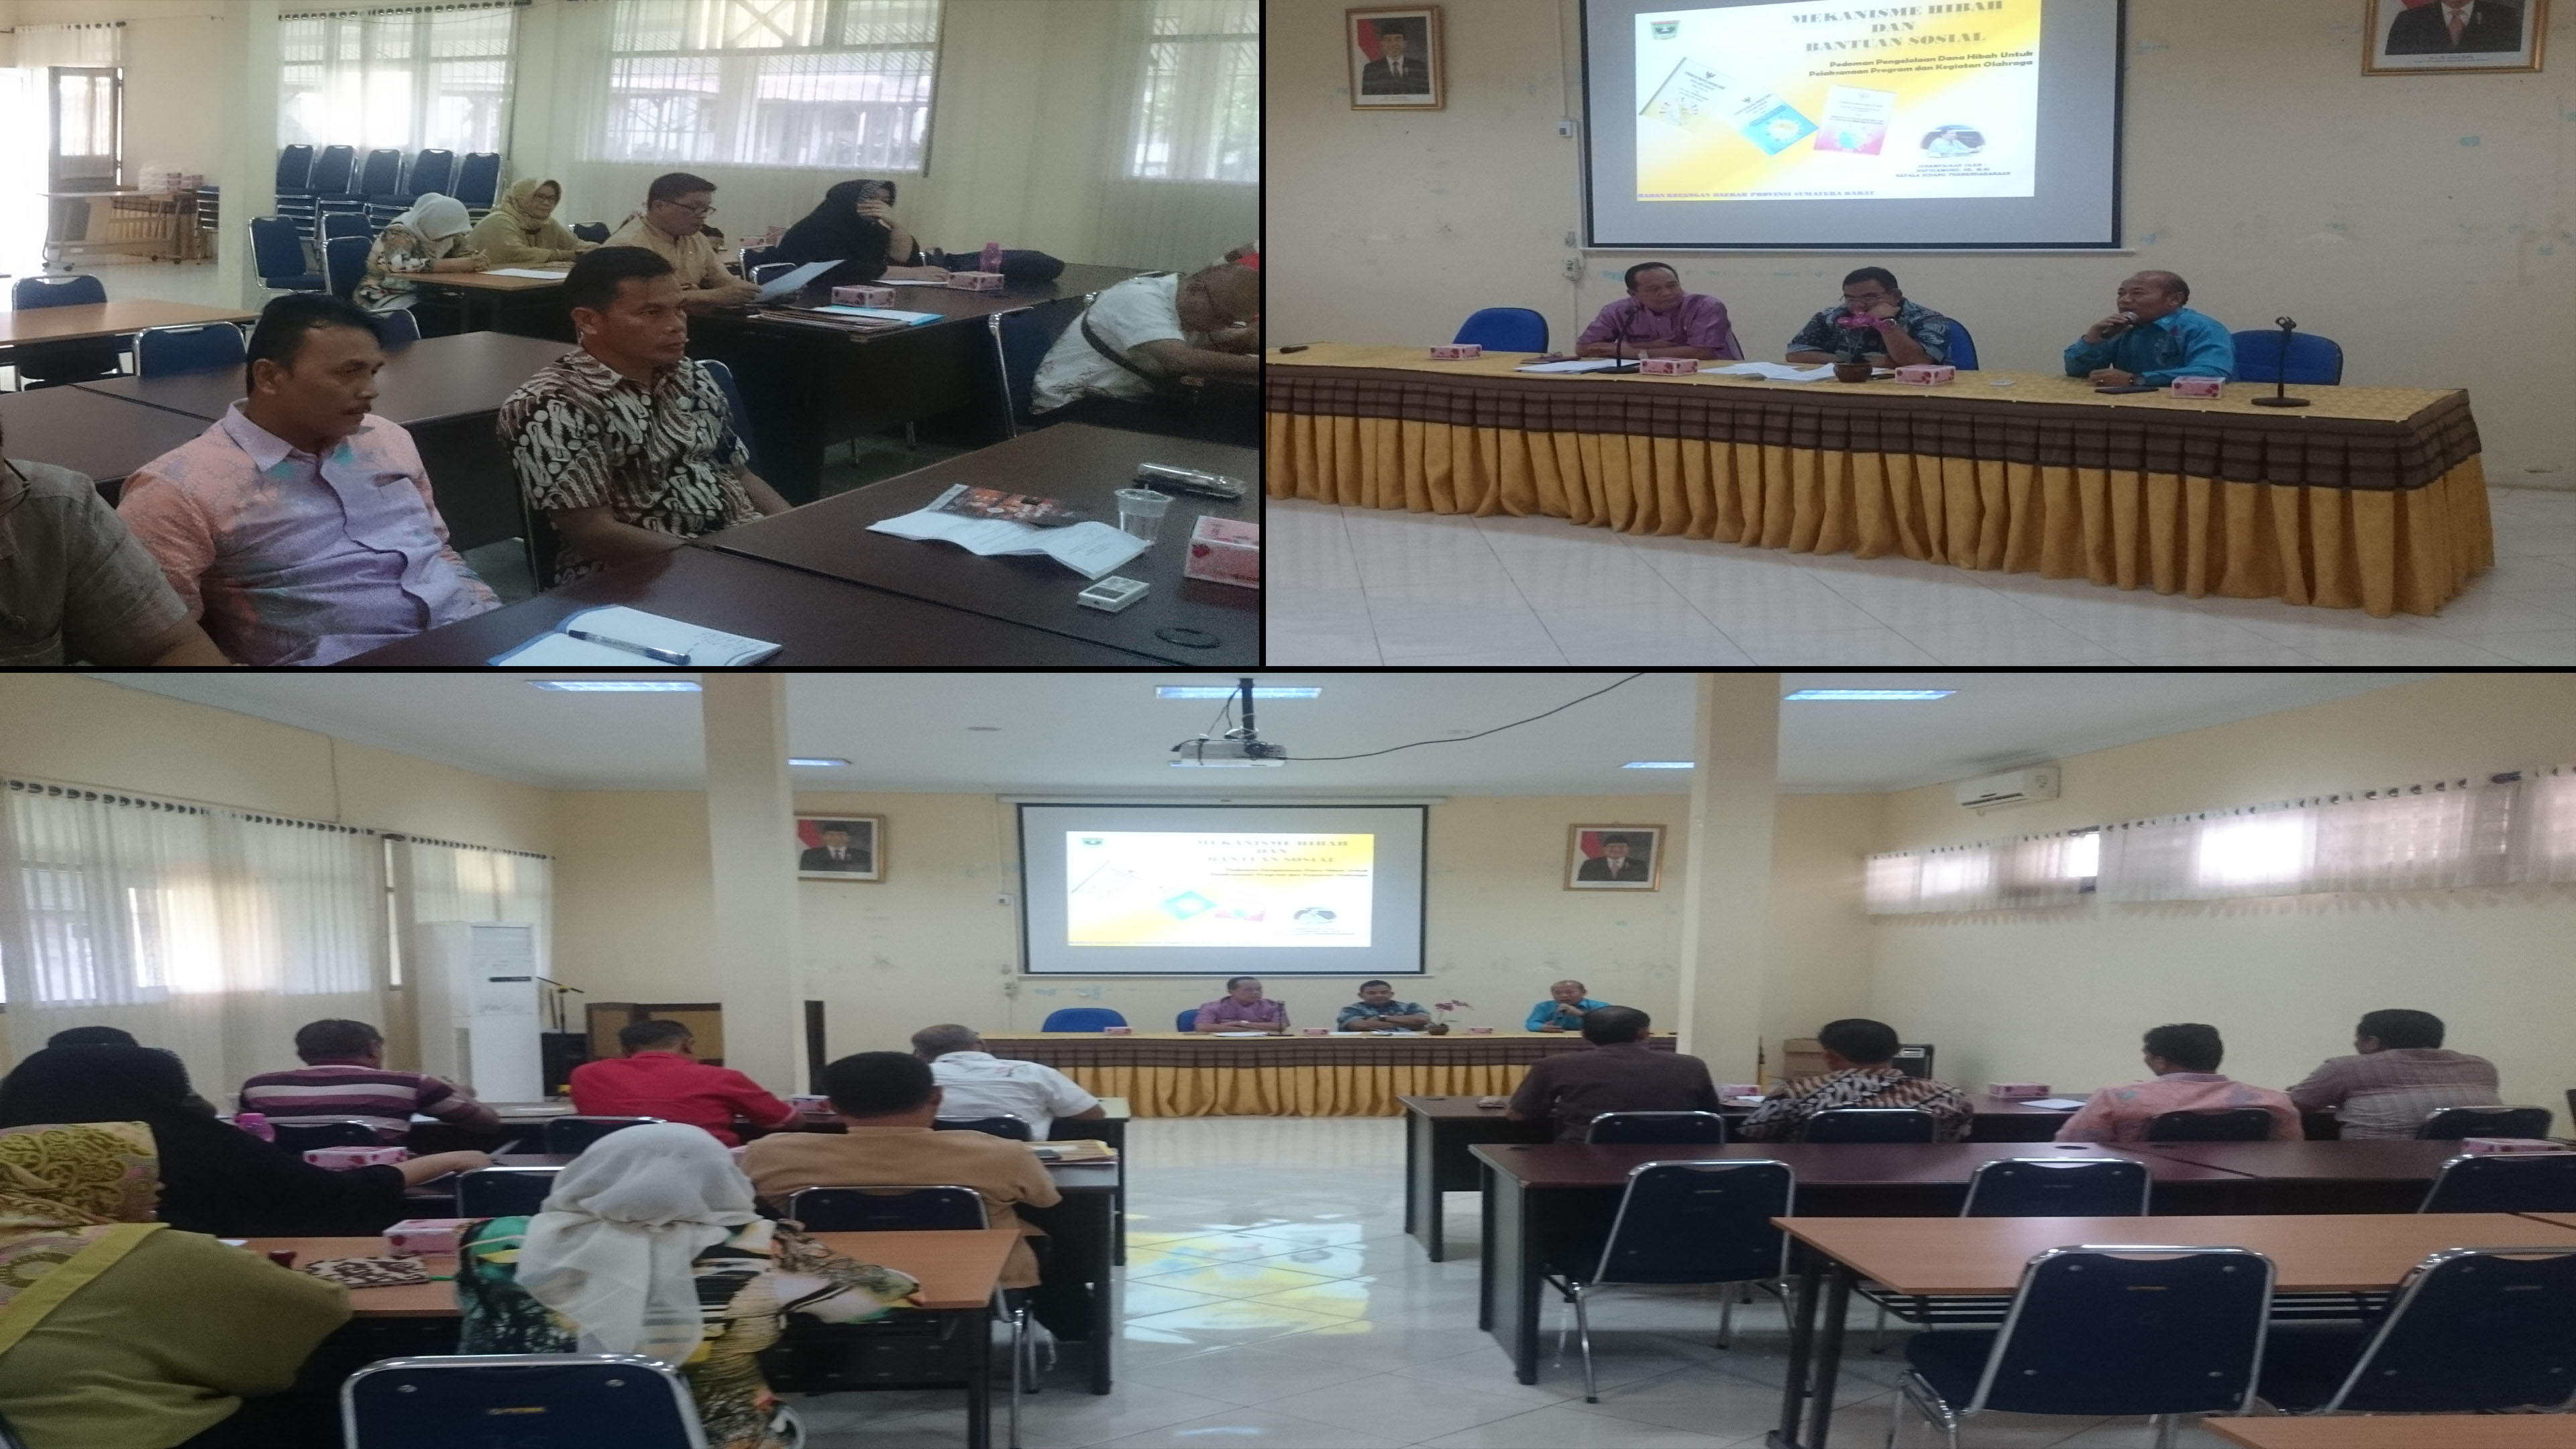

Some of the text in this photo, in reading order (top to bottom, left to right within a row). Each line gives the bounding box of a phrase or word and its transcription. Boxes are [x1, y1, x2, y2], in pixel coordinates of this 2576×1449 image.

[1792, 1, 2003, 24] MEKANISME HIBAH
[1872, 21, 1915, 33] DAN
[1806, 32, 1986, 52] BANTUAN SOSIAL
[1876, 57, 1936, 65] Pengelolaan
